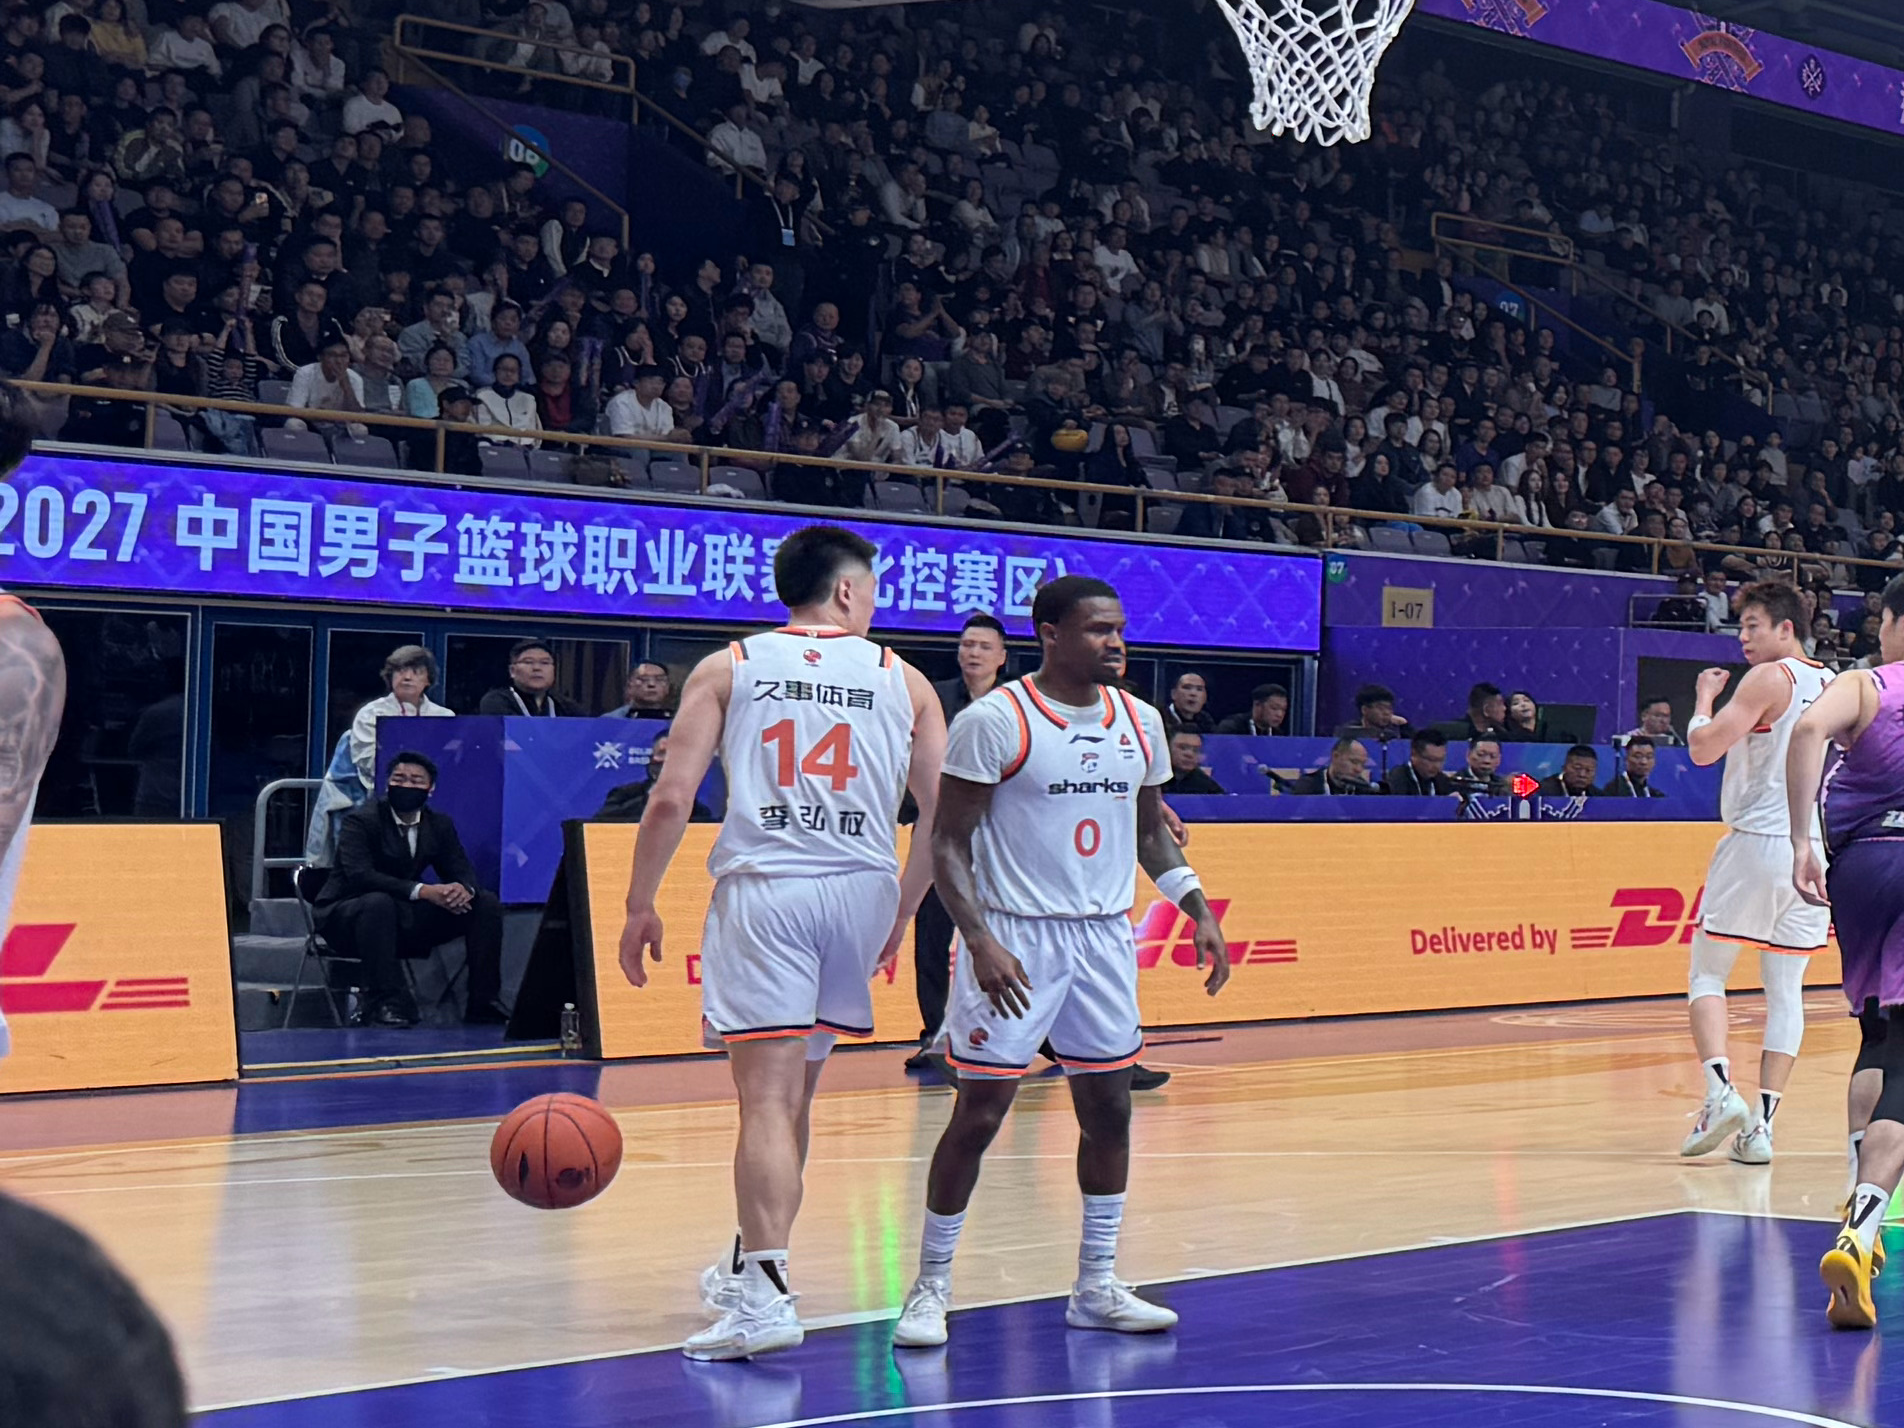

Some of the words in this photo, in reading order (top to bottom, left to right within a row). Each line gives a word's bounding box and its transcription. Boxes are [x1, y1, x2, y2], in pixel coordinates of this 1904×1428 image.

[1329, 561, 1345, 575] 07
[753, 679, 874, 710] 久事体育
[761, 718, 858, 792] 14
[1048, 776, 1129, 796] sharks
[1074, 818, 1101, 858] 0
[1410, 925, 1526, 956] Delivered
[1529, 927, 1558, 956] by
